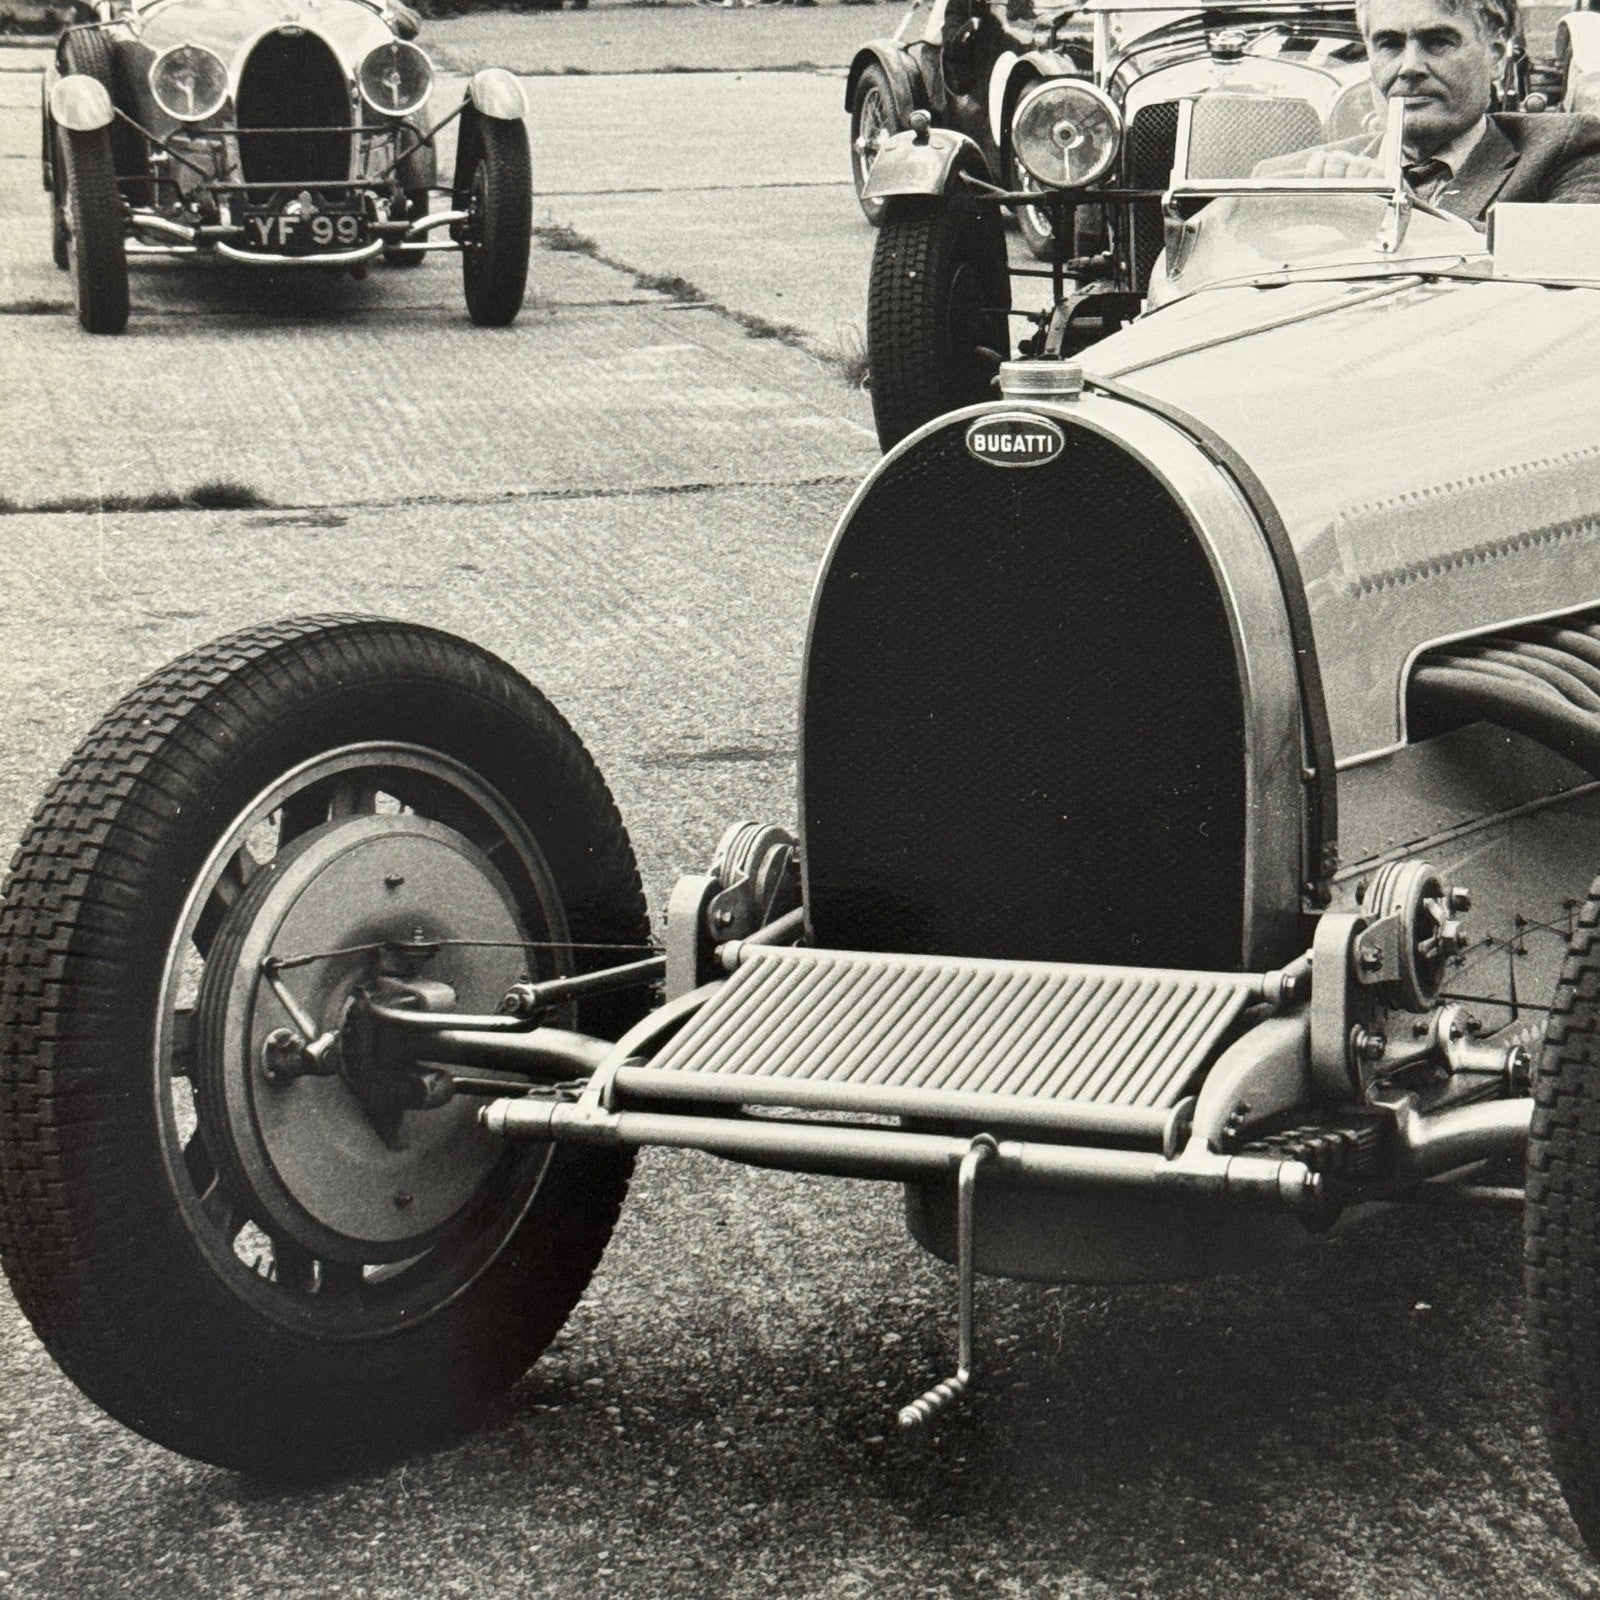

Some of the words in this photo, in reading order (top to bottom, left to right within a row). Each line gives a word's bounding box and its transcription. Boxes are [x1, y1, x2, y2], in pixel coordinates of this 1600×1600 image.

[256, 216, 300, 246] YF
[312, 215, 358, 245] 99
[974, 434, 1053, 453] BUGATTI
